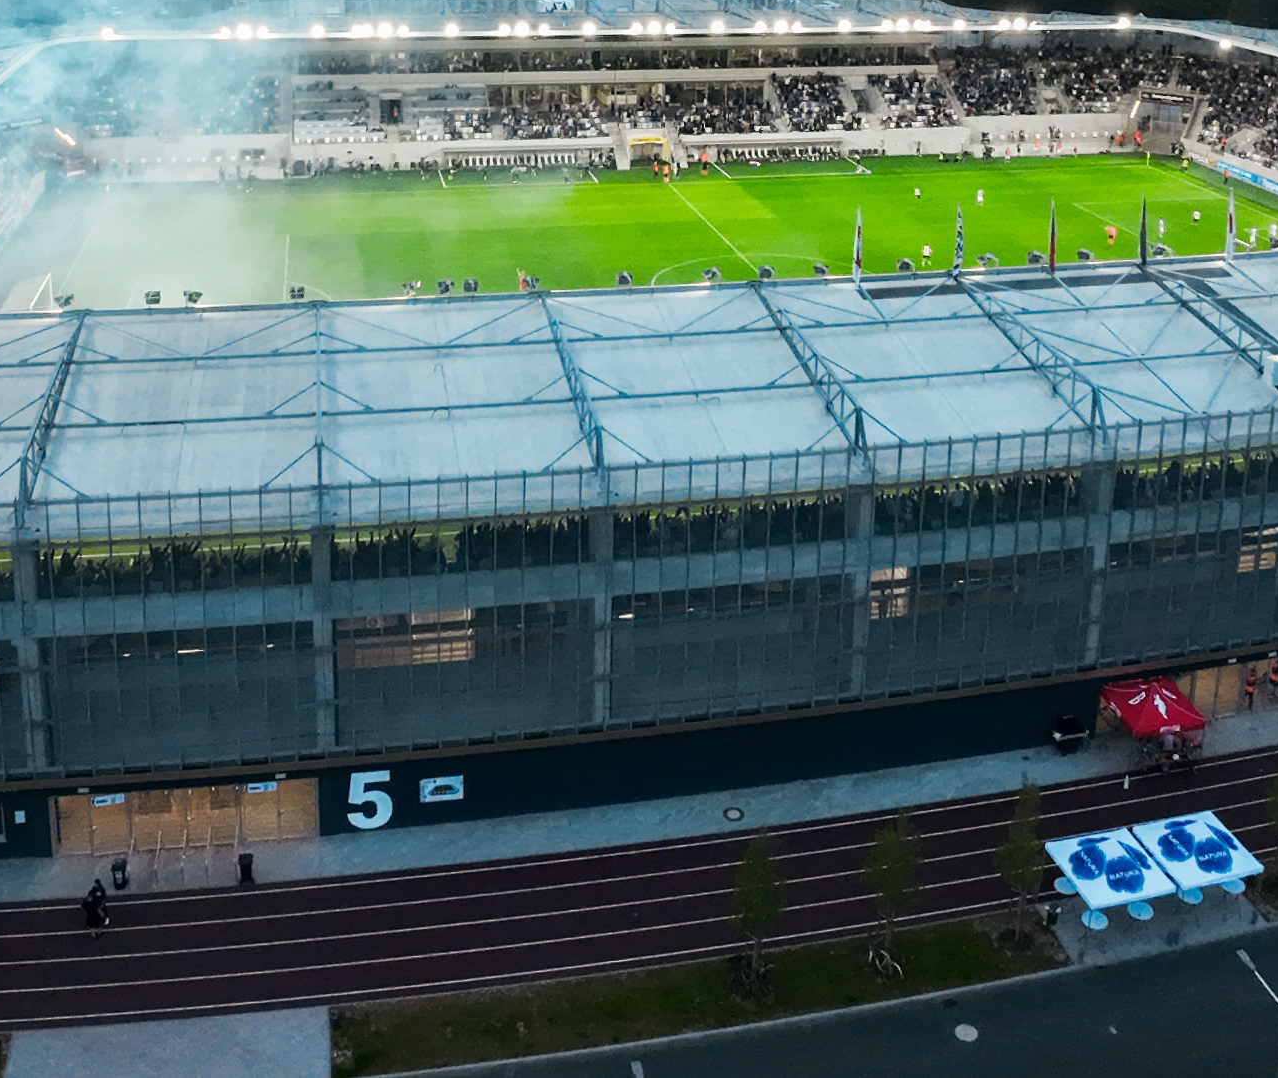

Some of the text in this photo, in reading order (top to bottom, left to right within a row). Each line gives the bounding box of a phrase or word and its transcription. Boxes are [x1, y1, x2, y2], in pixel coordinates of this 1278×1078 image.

[346, 769, 393, 830] 5
[1198, 851, 1227, 862] NATURA
[1108, 869, 1141, 881] NATURA
